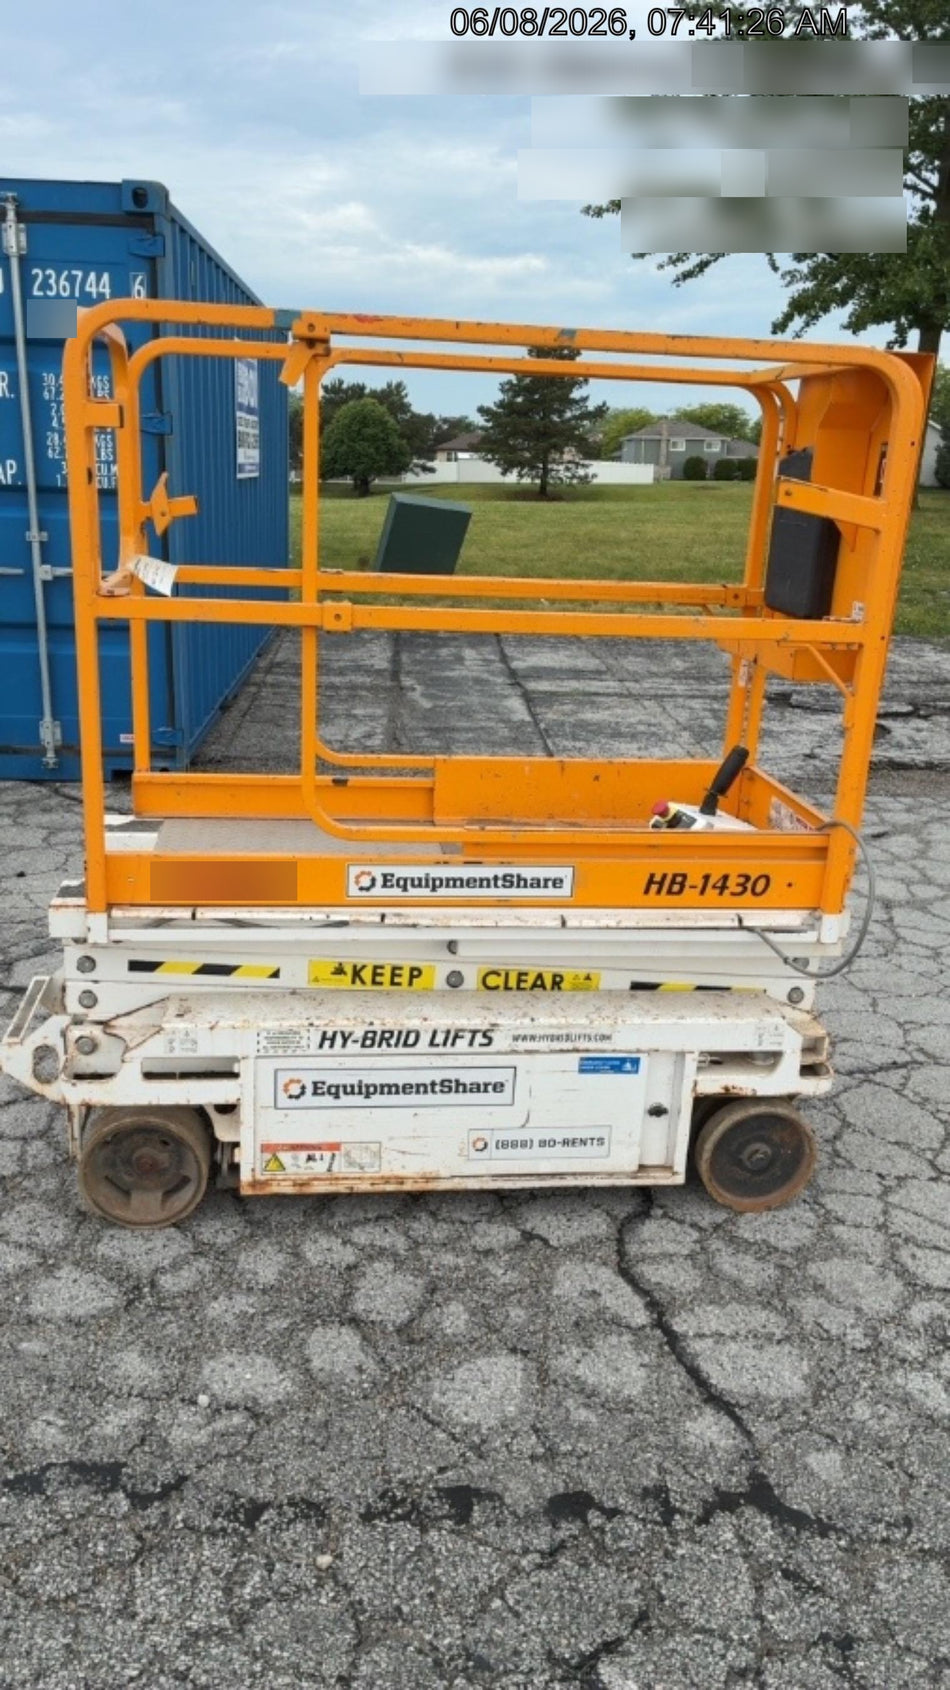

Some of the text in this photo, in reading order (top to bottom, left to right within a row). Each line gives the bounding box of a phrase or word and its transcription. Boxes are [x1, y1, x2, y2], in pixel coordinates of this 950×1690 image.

[31, 268, 111, 299] 236744
[133, 274, 144, 299] 6
[381, 873, 564, 892] EquipmentShare
[643, 873, 771, 896] HB-1430
[350, 964, 423, 987] KEEP
[482, 970, 565, 991] CLEAR
[318, 1030, 420, 1049] HY-BRID
[428, 1028, 494, 1048] LIFTS
[312, 1079, 506, 1100] EquipmentShare
[495, 1138, 533, 1150] (888)
